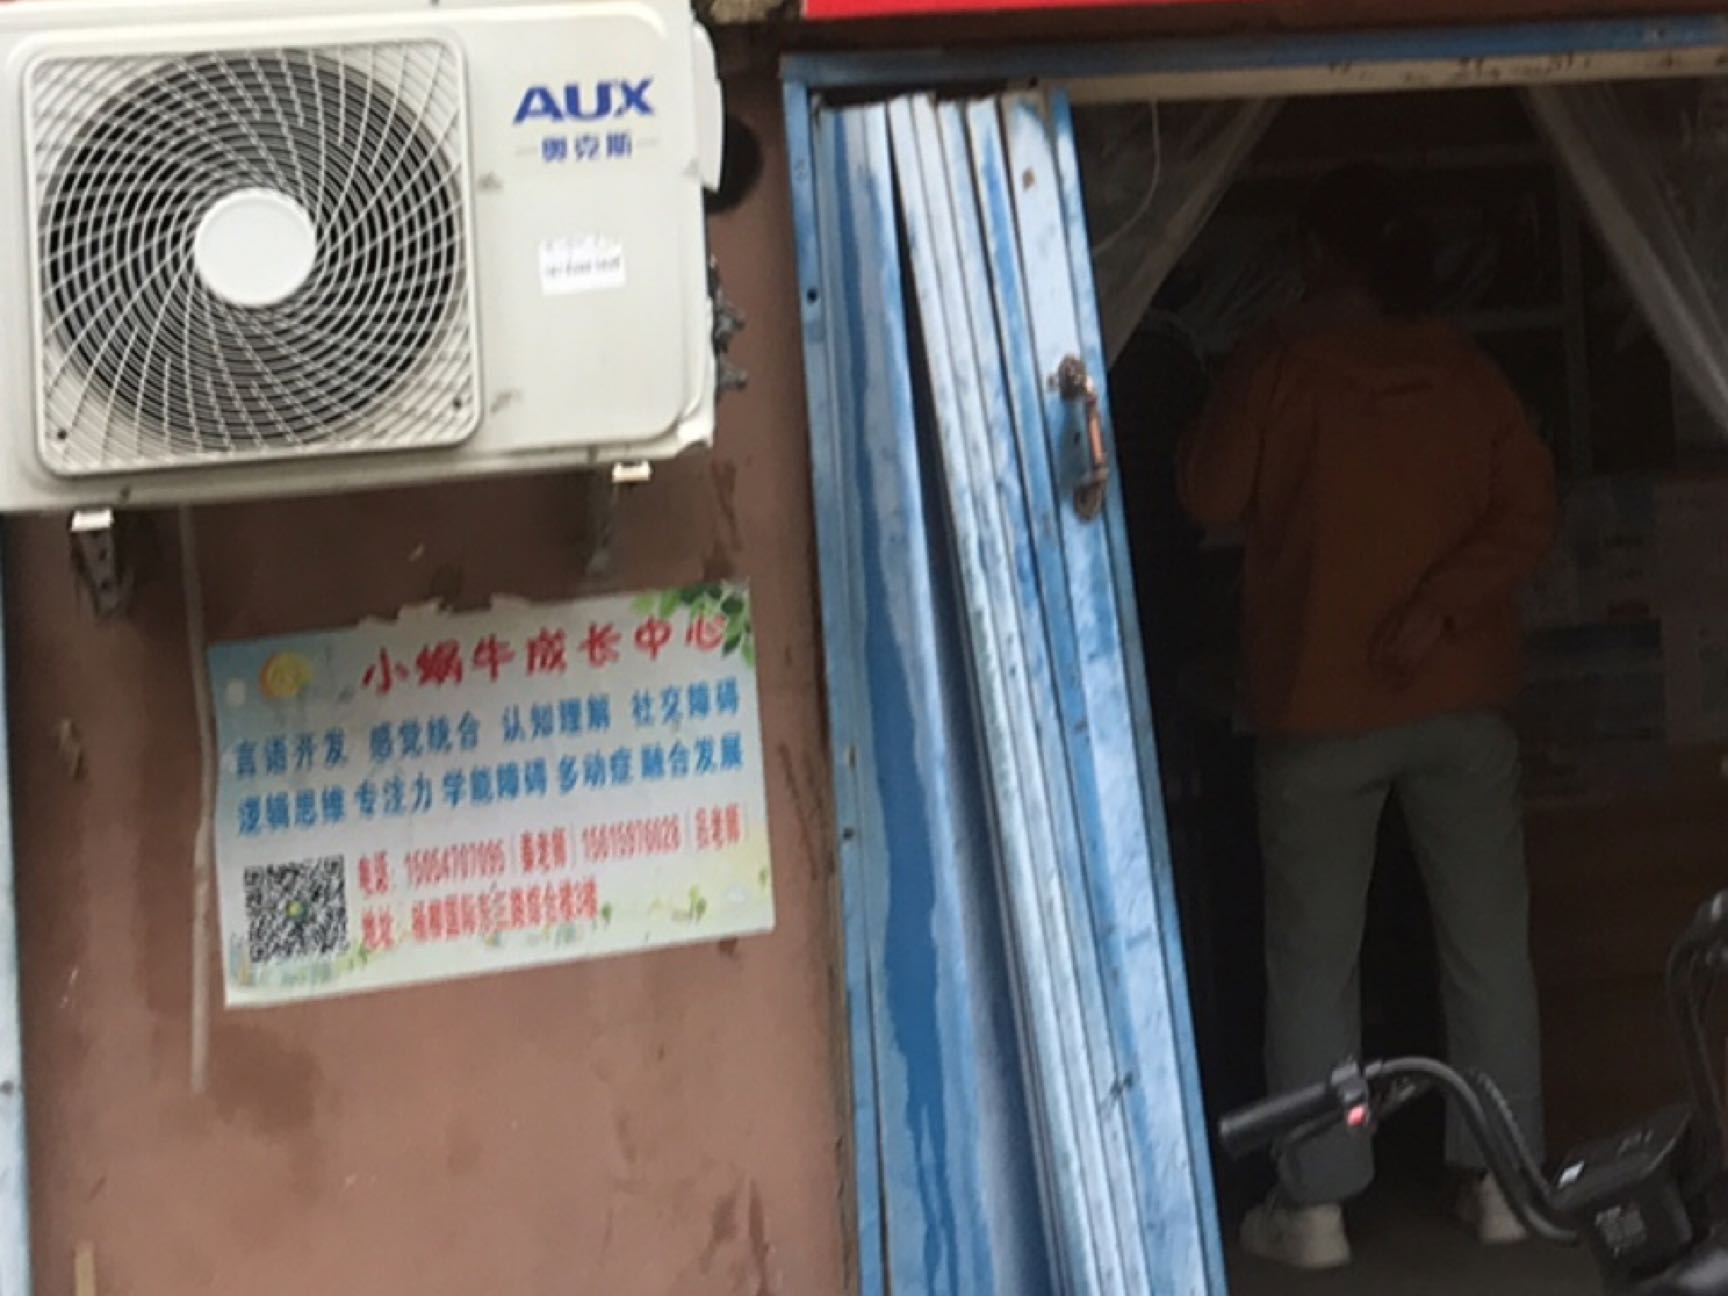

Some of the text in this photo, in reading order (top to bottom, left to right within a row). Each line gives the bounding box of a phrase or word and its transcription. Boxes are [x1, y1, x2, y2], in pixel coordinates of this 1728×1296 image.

[512, 75, 654, 126] AUX
[362, 615, 726, 695] 小蜗牛成长中心
